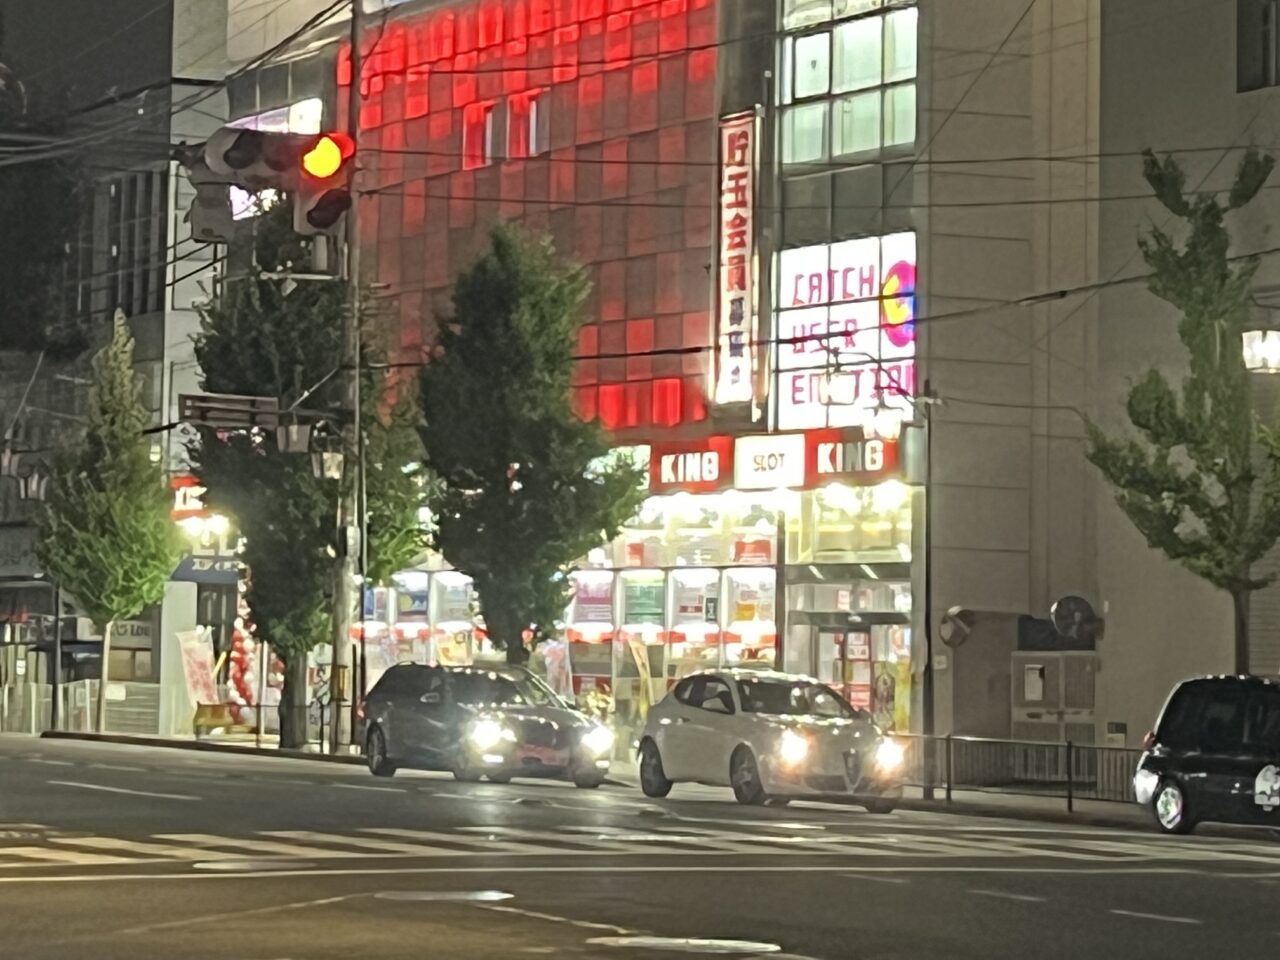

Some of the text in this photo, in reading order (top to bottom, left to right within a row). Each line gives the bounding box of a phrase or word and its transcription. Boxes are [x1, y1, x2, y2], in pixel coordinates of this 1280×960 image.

[793, 265, 875, 305] CATCH
[661, 440, 883, 483] KING SLOT KING
